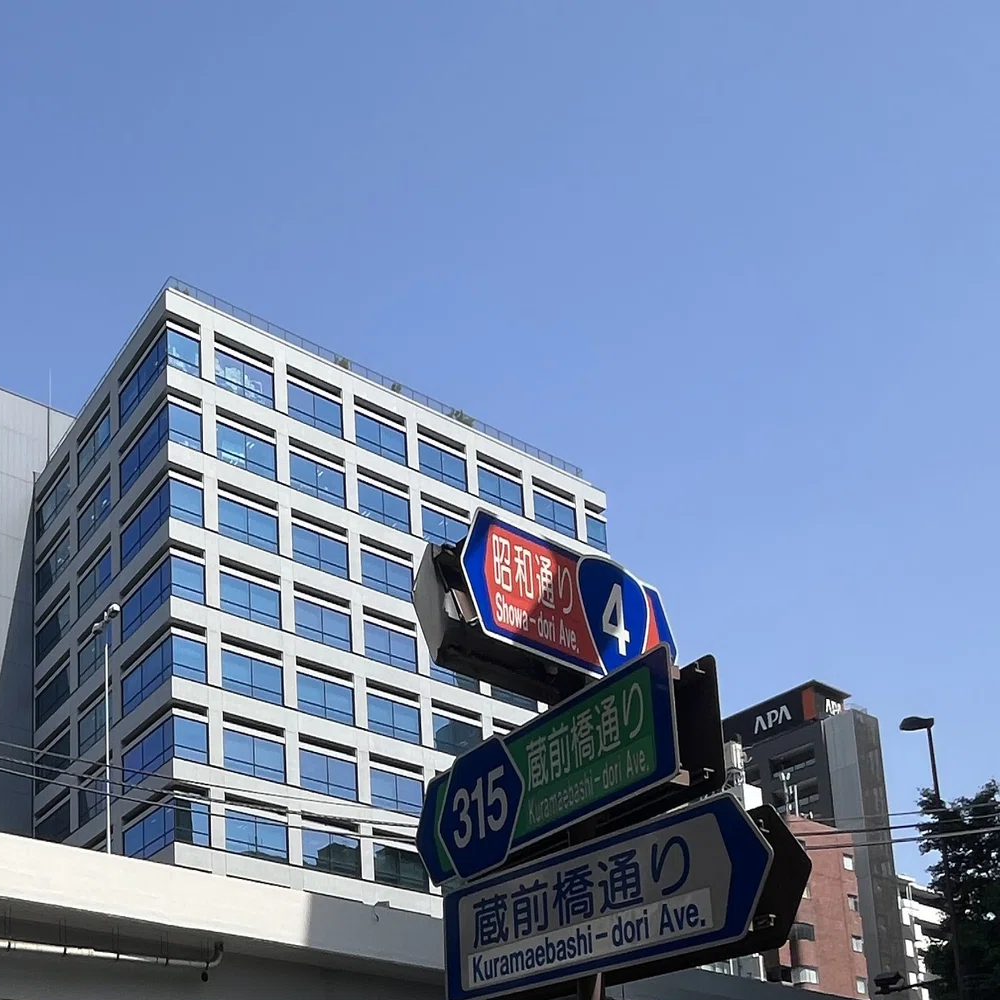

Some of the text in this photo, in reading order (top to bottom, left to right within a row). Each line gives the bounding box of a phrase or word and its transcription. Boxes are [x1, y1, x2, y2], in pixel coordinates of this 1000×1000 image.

[491, 533, 574, 615] 昭和通り
[495, 592, 580, 654] Showa-dori Ave.
[602, 583, 631, 657] 4
[525, 682, 644, 791] 蔵前橋通り
[754, 704, 792, 735] APA
[452, 765, 508, 849] 315
[527, 749, 650, 825] Kuramaebashi-dori Ave.
[472, 835, 690, 949] 蔵前橋通り
[472, 903, 707, 984] Kuramaebashi-dori Ave.
